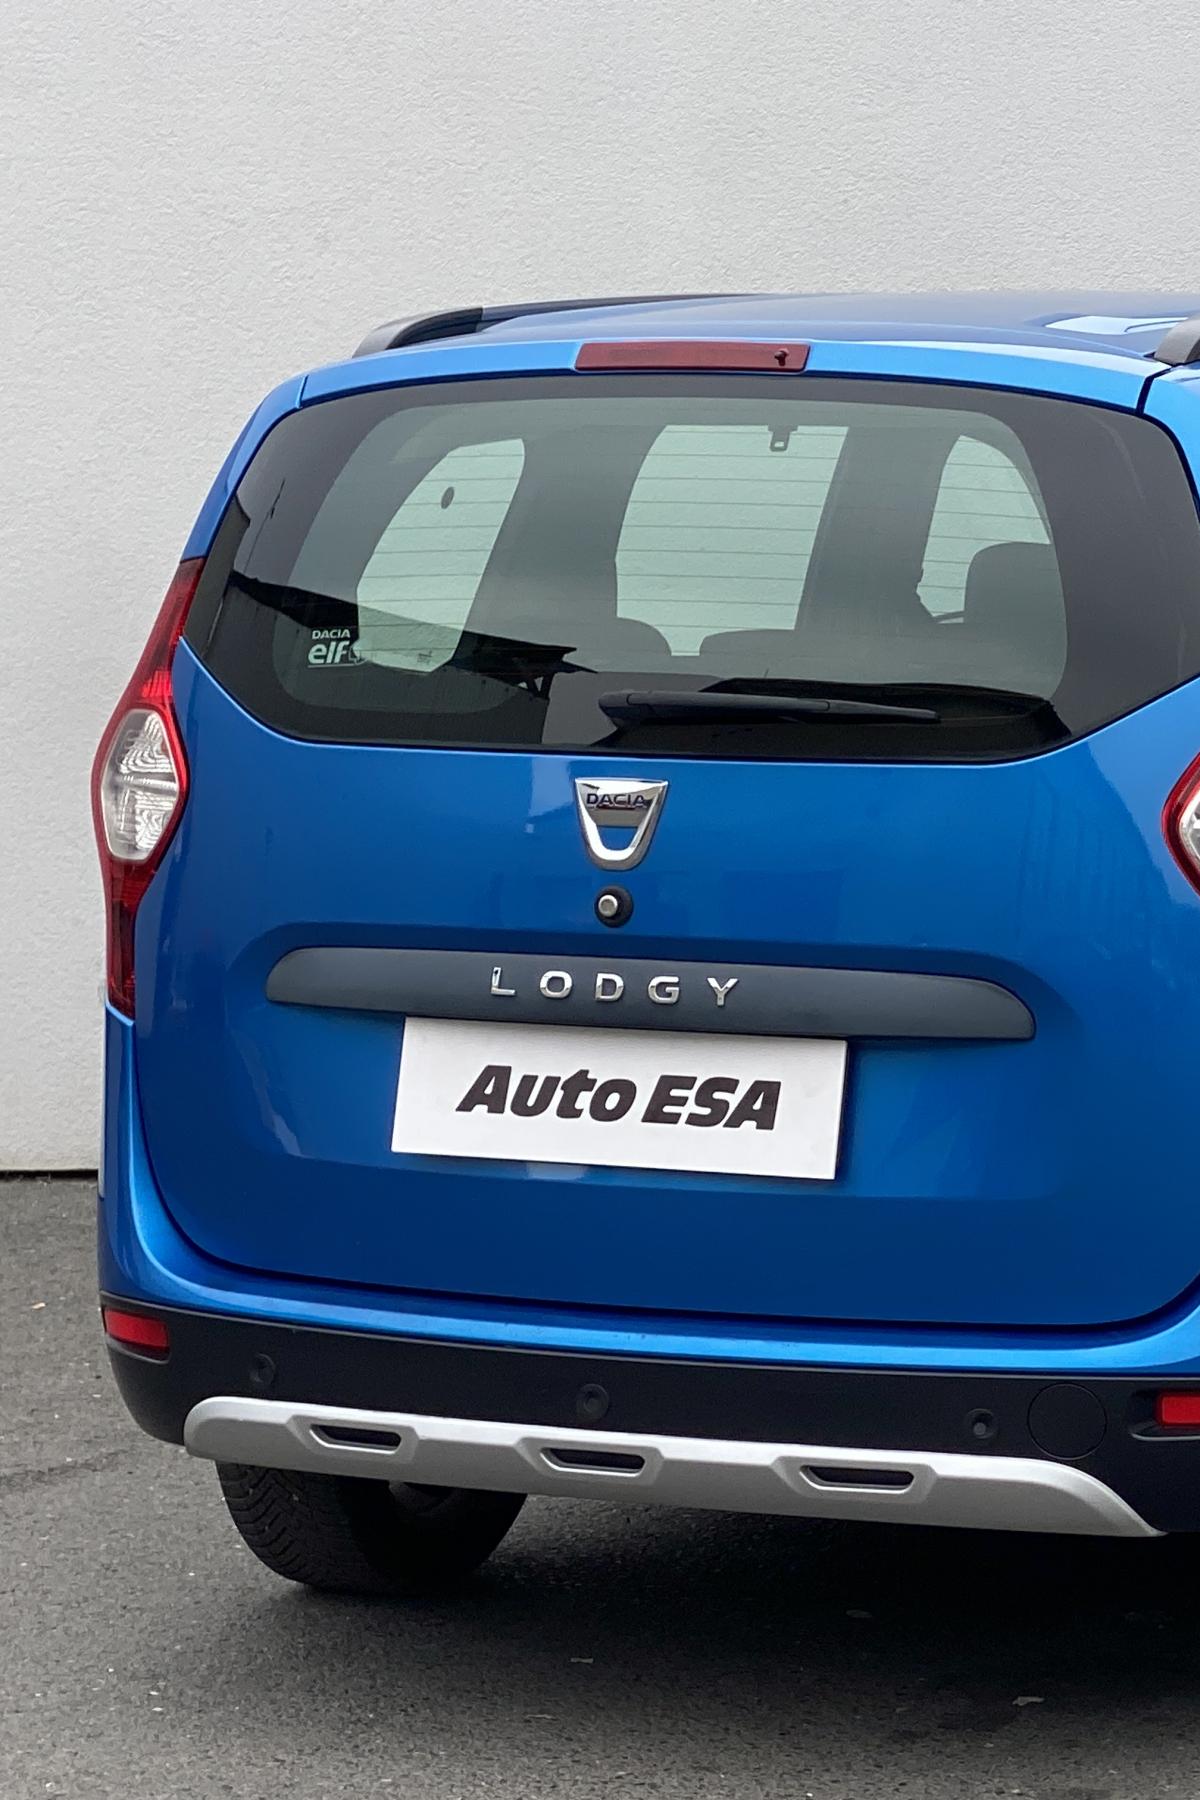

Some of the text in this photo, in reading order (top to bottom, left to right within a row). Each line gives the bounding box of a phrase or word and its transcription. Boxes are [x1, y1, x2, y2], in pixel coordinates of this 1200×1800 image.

[311, 629, 351, 640] DACIA
[308, 641, 350, 664] elf
[586, 793, 647, 808] DACIA
[490, 966, 740, 1007] LODGY
[455, 1064, 782, 1131] Auto ESA
